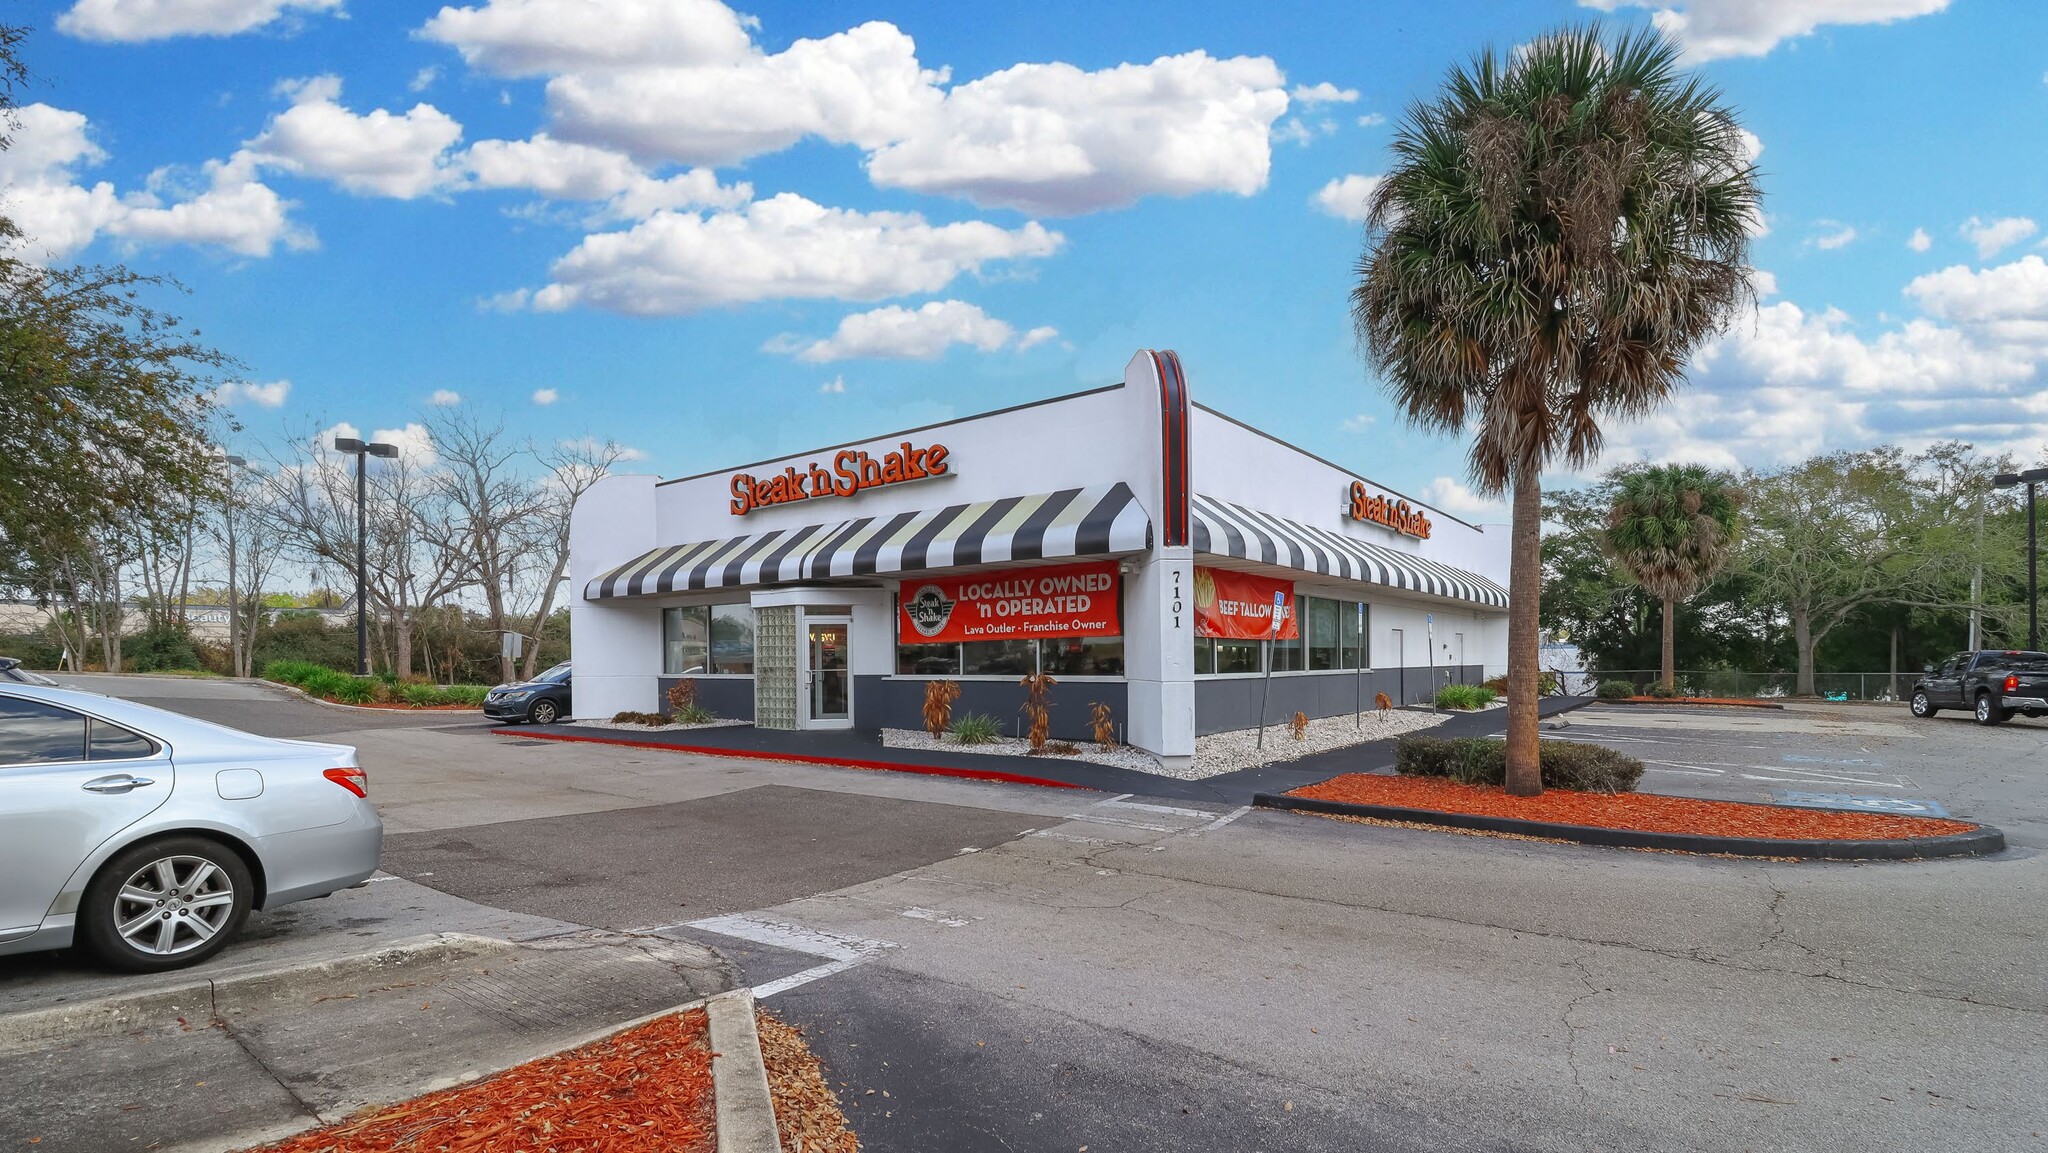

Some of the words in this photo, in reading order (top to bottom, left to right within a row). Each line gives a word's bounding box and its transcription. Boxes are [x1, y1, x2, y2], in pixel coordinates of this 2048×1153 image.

[731, 466, 809, 515] Steak
[834, 442, 950, 497] Shake
[1349, 480, 1388, 526] Steak
[1395, 499, 1432, 539] Shake
[959, 579, 1033, 601] LOCALLY
[1039, 573, 1112, 596] OWNED
[919, 597, 940, 608] Steak
[996, 595, 1091, 617] OPERATED
[1172, 571, 1182, 628] 7101
[1218, 599, 1239, 616] BEEF
[1240, 602, 1272, 618] TALLOW
[919, 612, 942, 623] Shake
[964, 624, 984, 635] Lava
[986, 622, 1015, 634] Outler
[1023, 621, 1069, 632] Franchise
[1071, 619, 1107, 630] Owner
